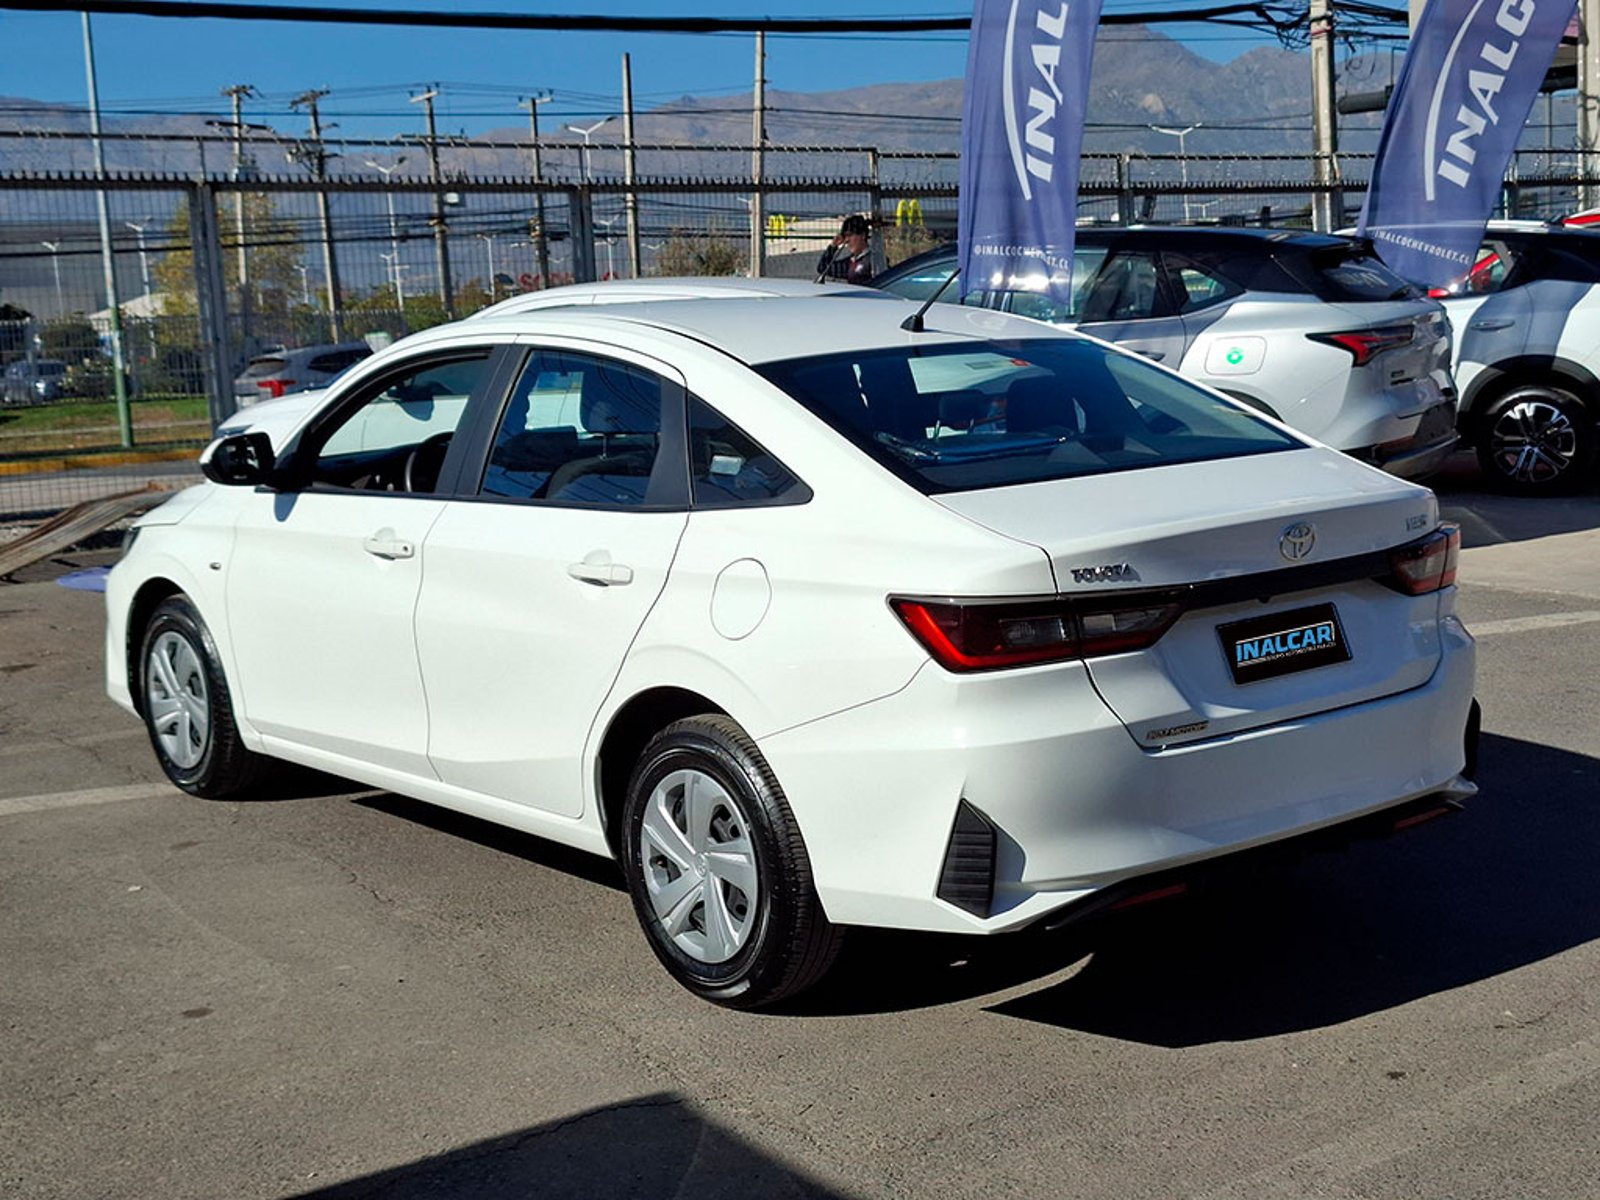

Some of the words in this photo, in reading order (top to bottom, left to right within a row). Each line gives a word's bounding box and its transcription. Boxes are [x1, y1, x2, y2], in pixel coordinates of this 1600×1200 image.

[1026, 2, 1068, 182] INAL
[1070, 563, 1138, 583] TOYOTA
[1236, 625, 1332, 662] INALCAR
